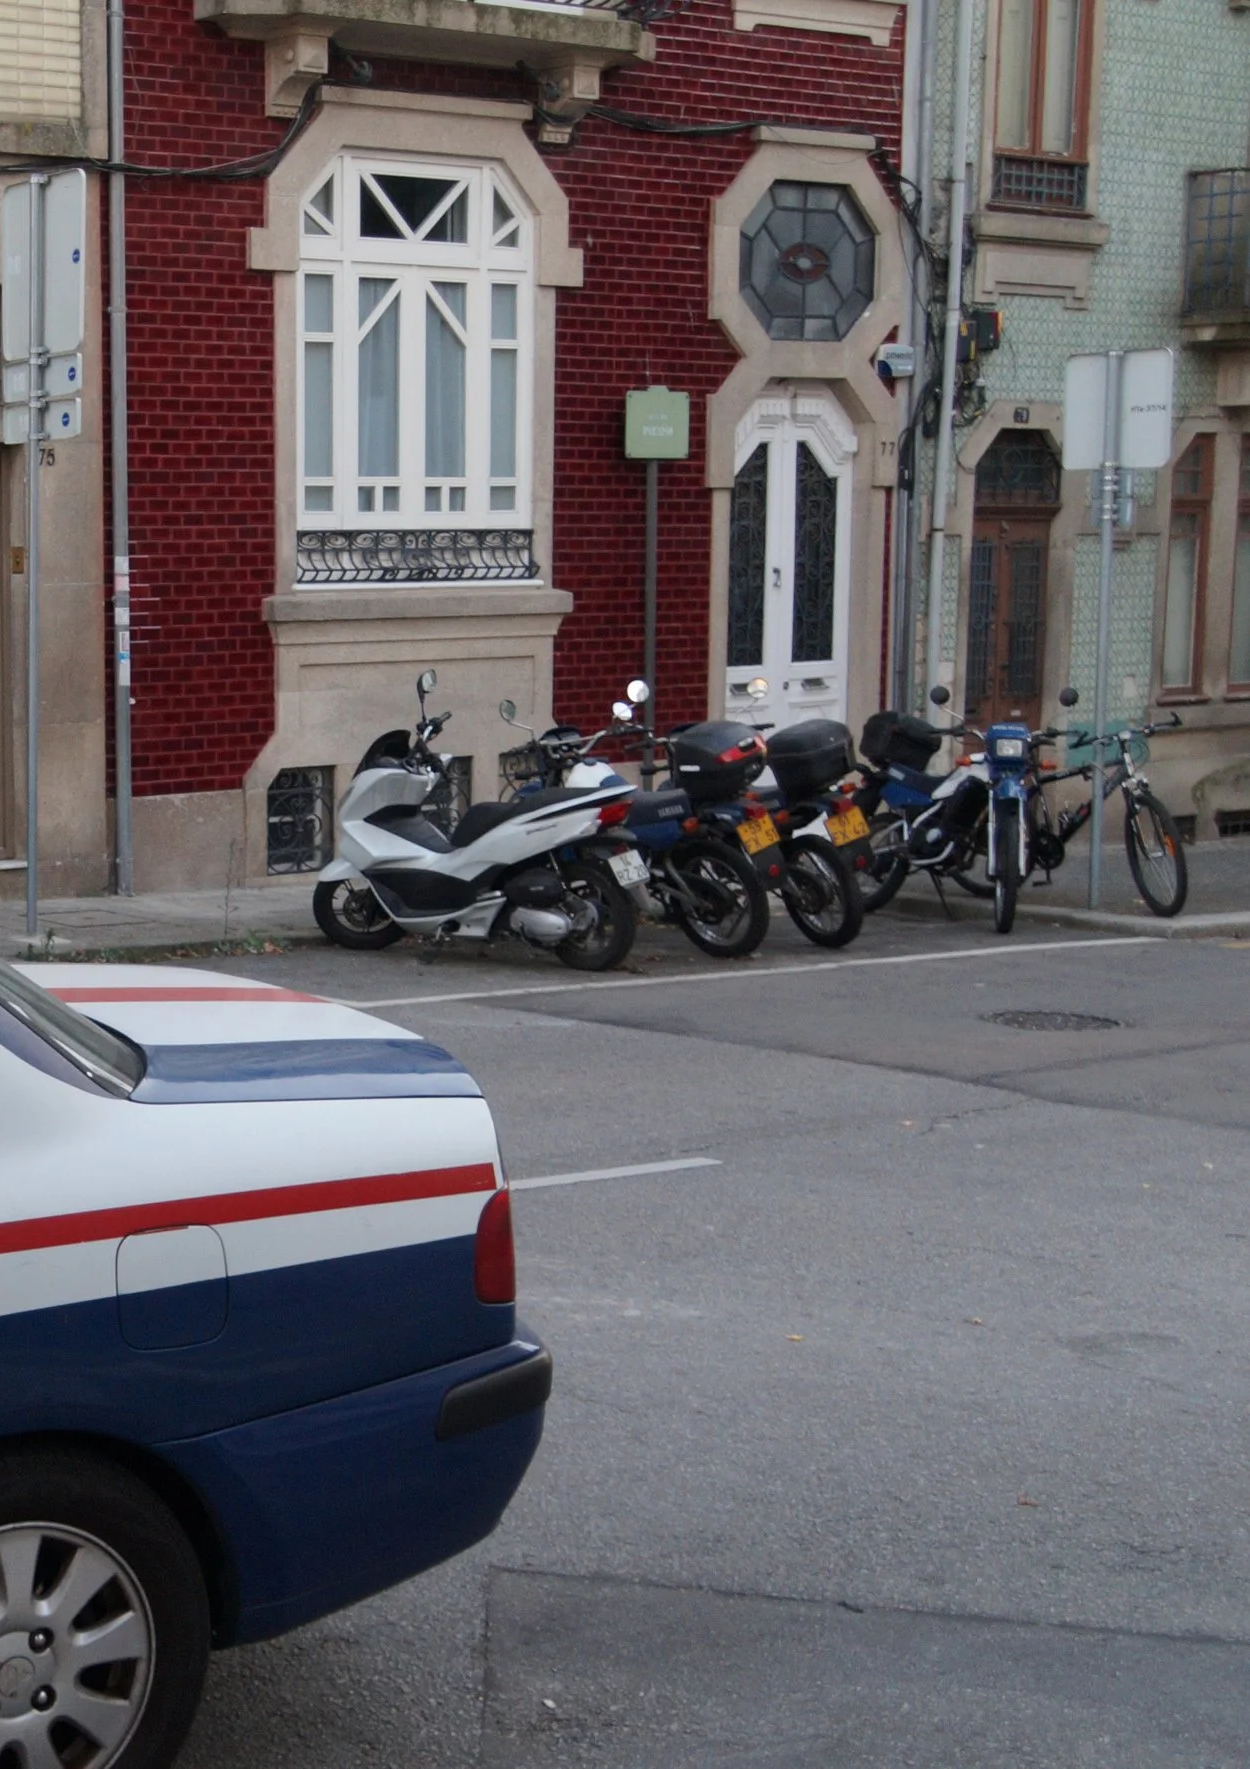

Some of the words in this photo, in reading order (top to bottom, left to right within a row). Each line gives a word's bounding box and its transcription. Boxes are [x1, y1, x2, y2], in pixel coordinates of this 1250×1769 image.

[38, 448, 56, 467] 75
[880, 441, 896, 458] 77
[616, 867, 635, 884] RZ
